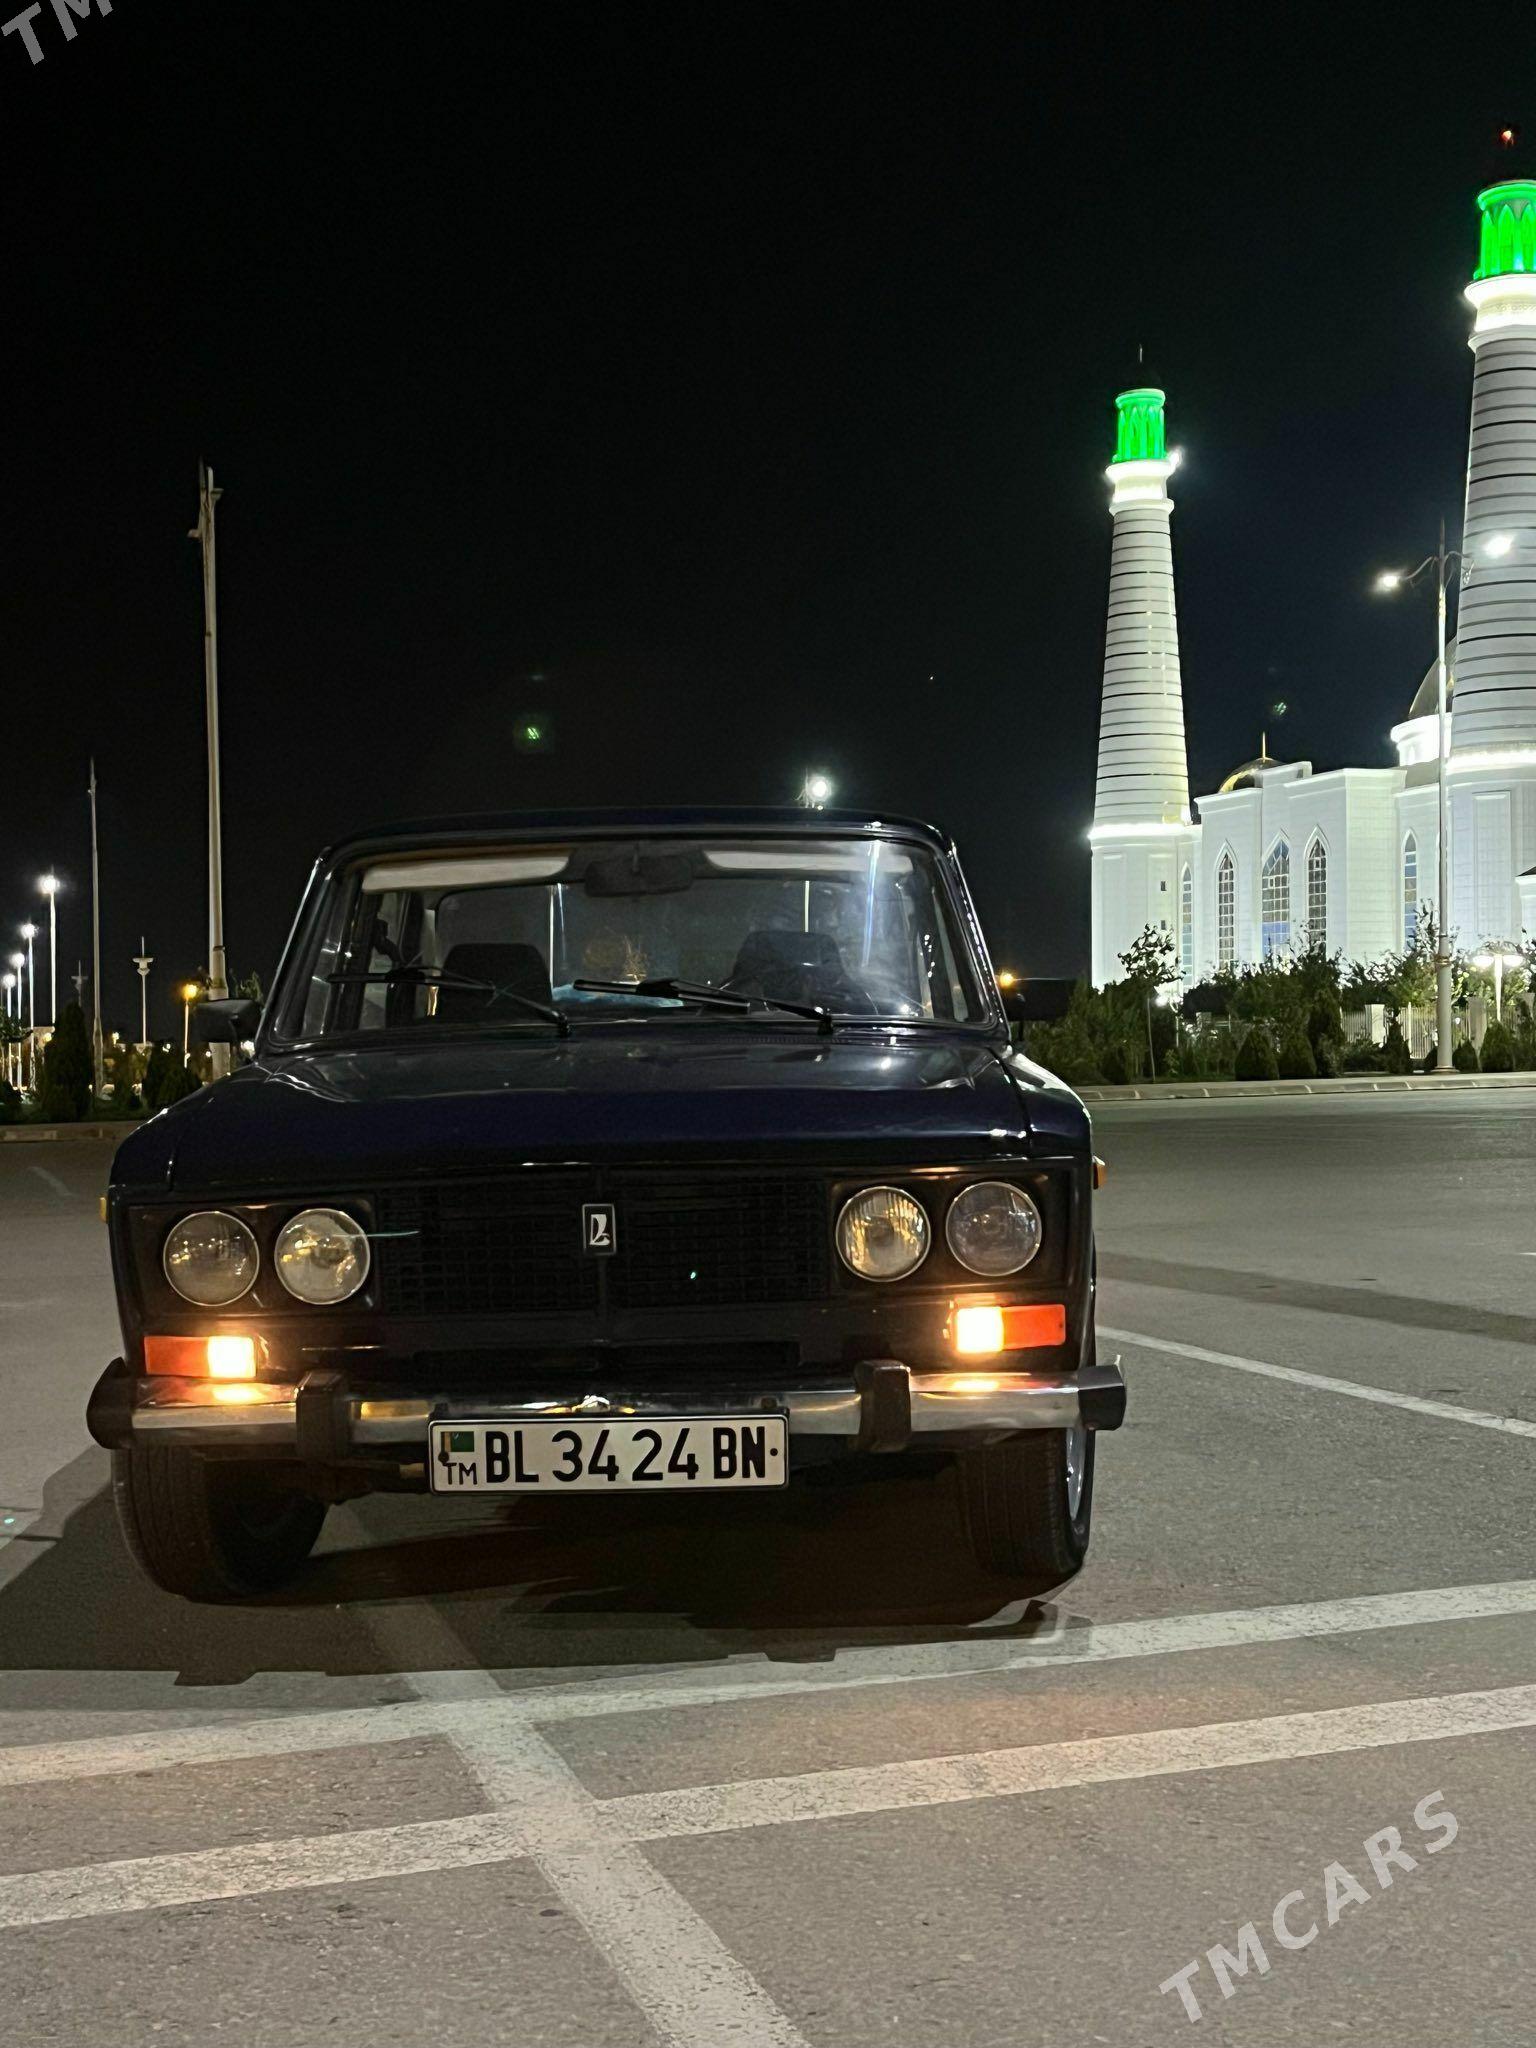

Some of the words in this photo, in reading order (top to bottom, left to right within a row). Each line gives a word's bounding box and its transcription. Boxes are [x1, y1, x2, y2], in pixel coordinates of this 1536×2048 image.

[446, 1462, 478, 1486] TM
[485, 1430, 540, 1483] BL
[712, 1425, 767, 1480] BN
